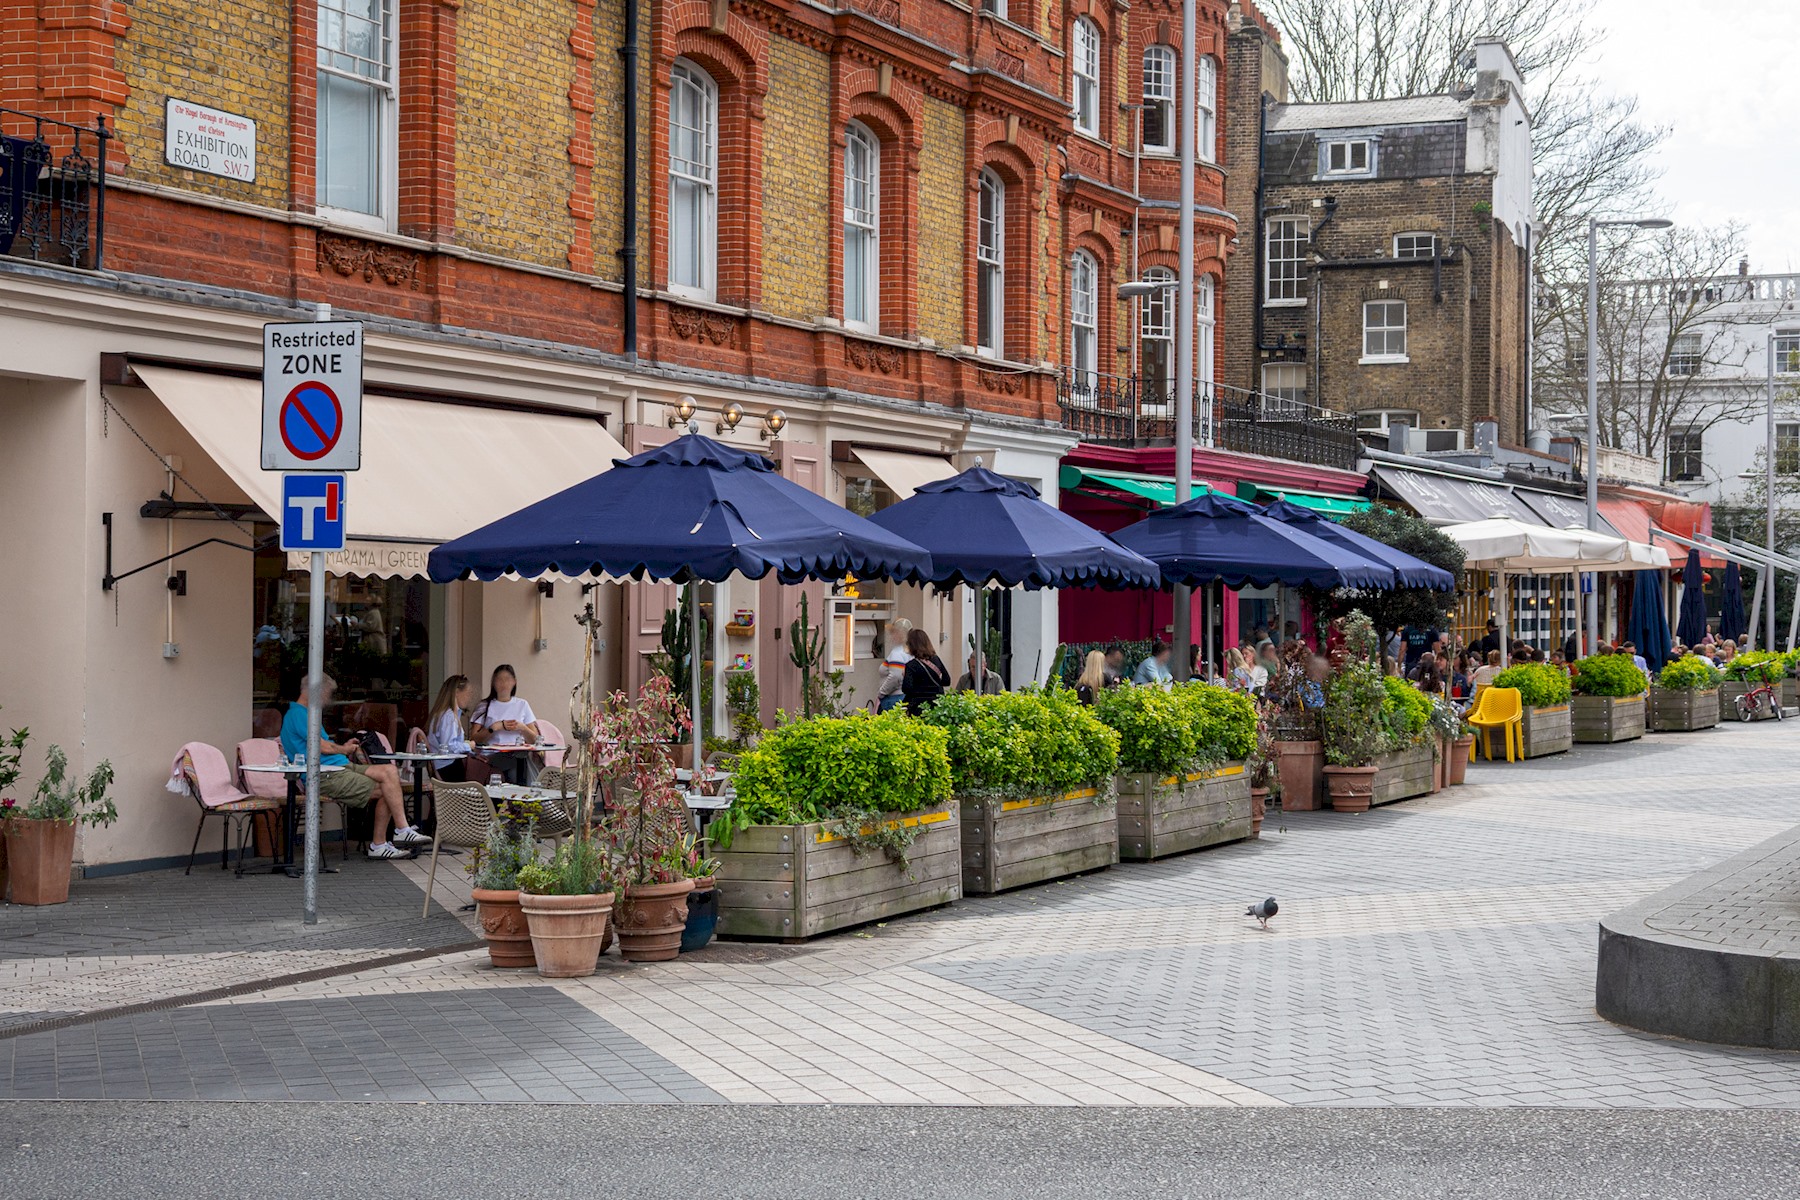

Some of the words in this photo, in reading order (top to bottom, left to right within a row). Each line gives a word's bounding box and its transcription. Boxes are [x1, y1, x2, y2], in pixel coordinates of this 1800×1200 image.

[175, 105, 184, 113] The
[185, 107, 198, 119] Royal
[199, 111, 217, 124] Borough
[225, 117, 248, 131] Kensington
[208, 126, 225, 137] Chelsea
[177, 129, 248, 160] EXHIBITION
[272, 330, 355, 348] Restricted
[282, 354, 342, 375] ZONE
